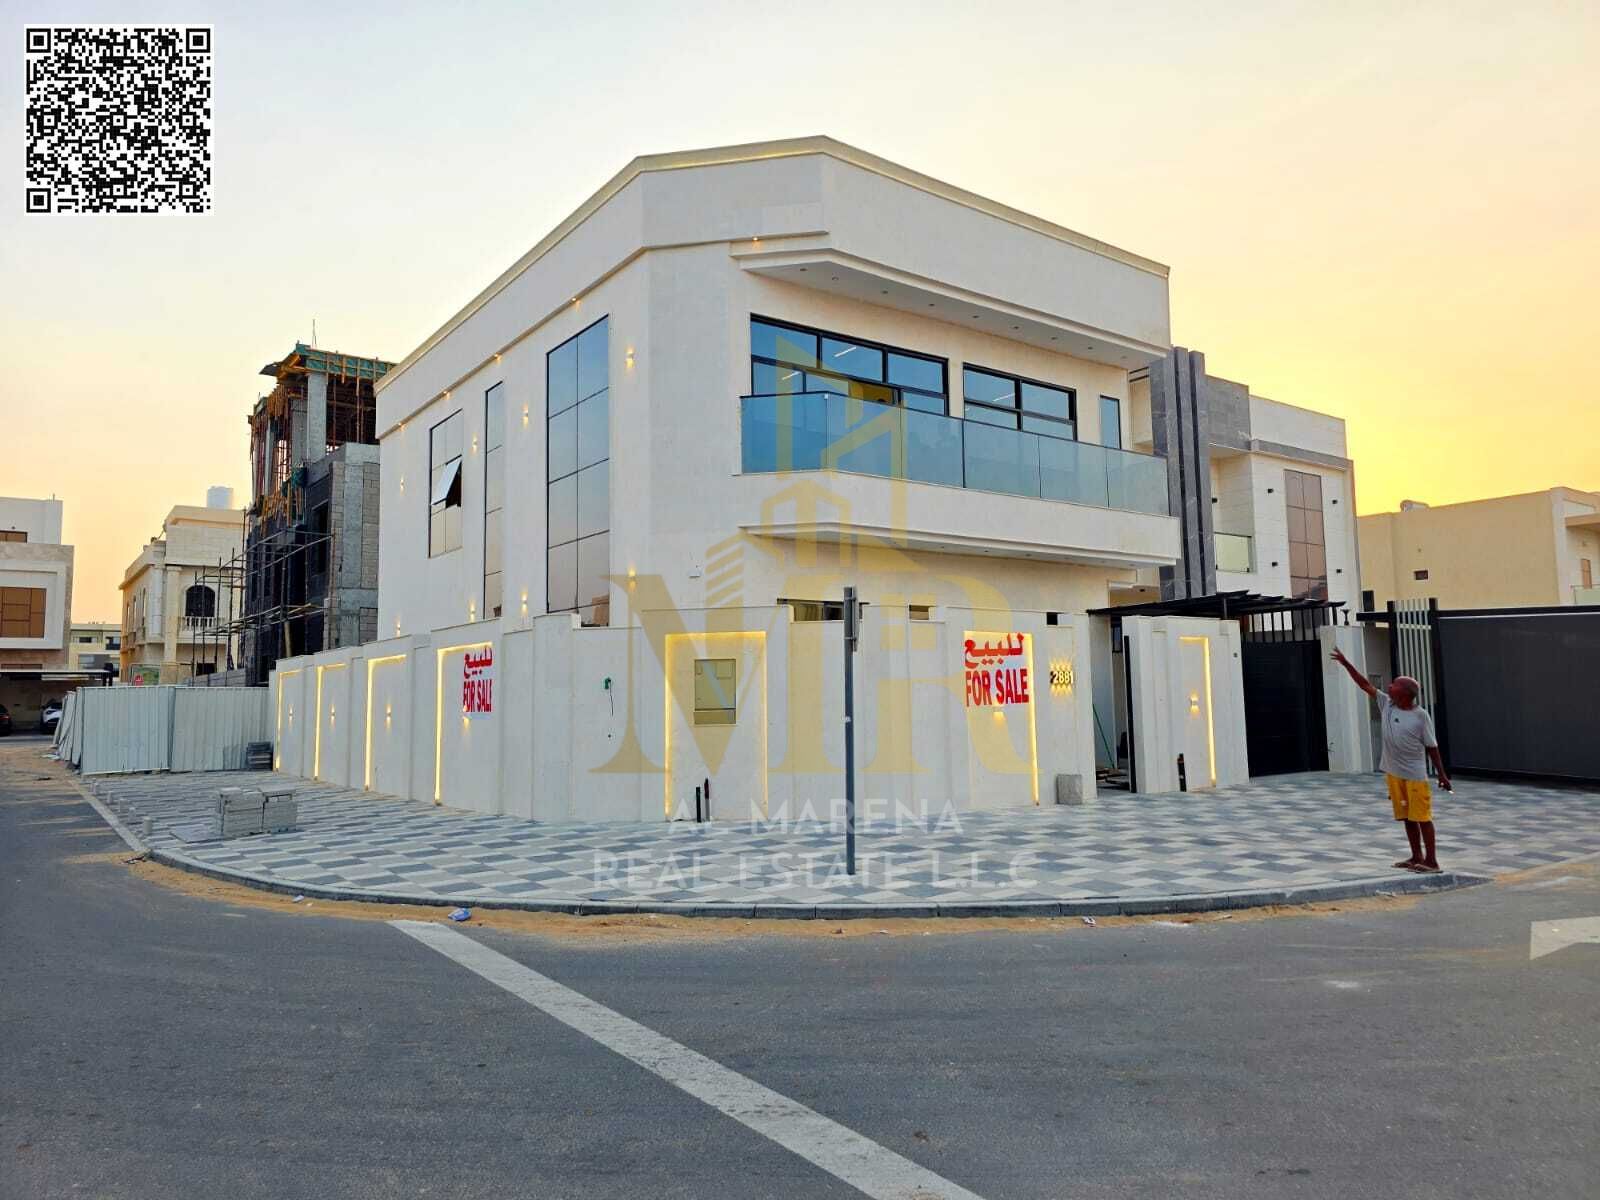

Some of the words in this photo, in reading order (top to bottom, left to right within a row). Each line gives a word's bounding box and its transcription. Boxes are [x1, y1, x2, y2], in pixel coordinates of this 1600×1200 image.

[965, 670, 992, 707] FOR
[995, 668, 1029, 705] SALE
[1050, 671, 1074, 684] 2881
[463, 680, 476, 713] FOR
